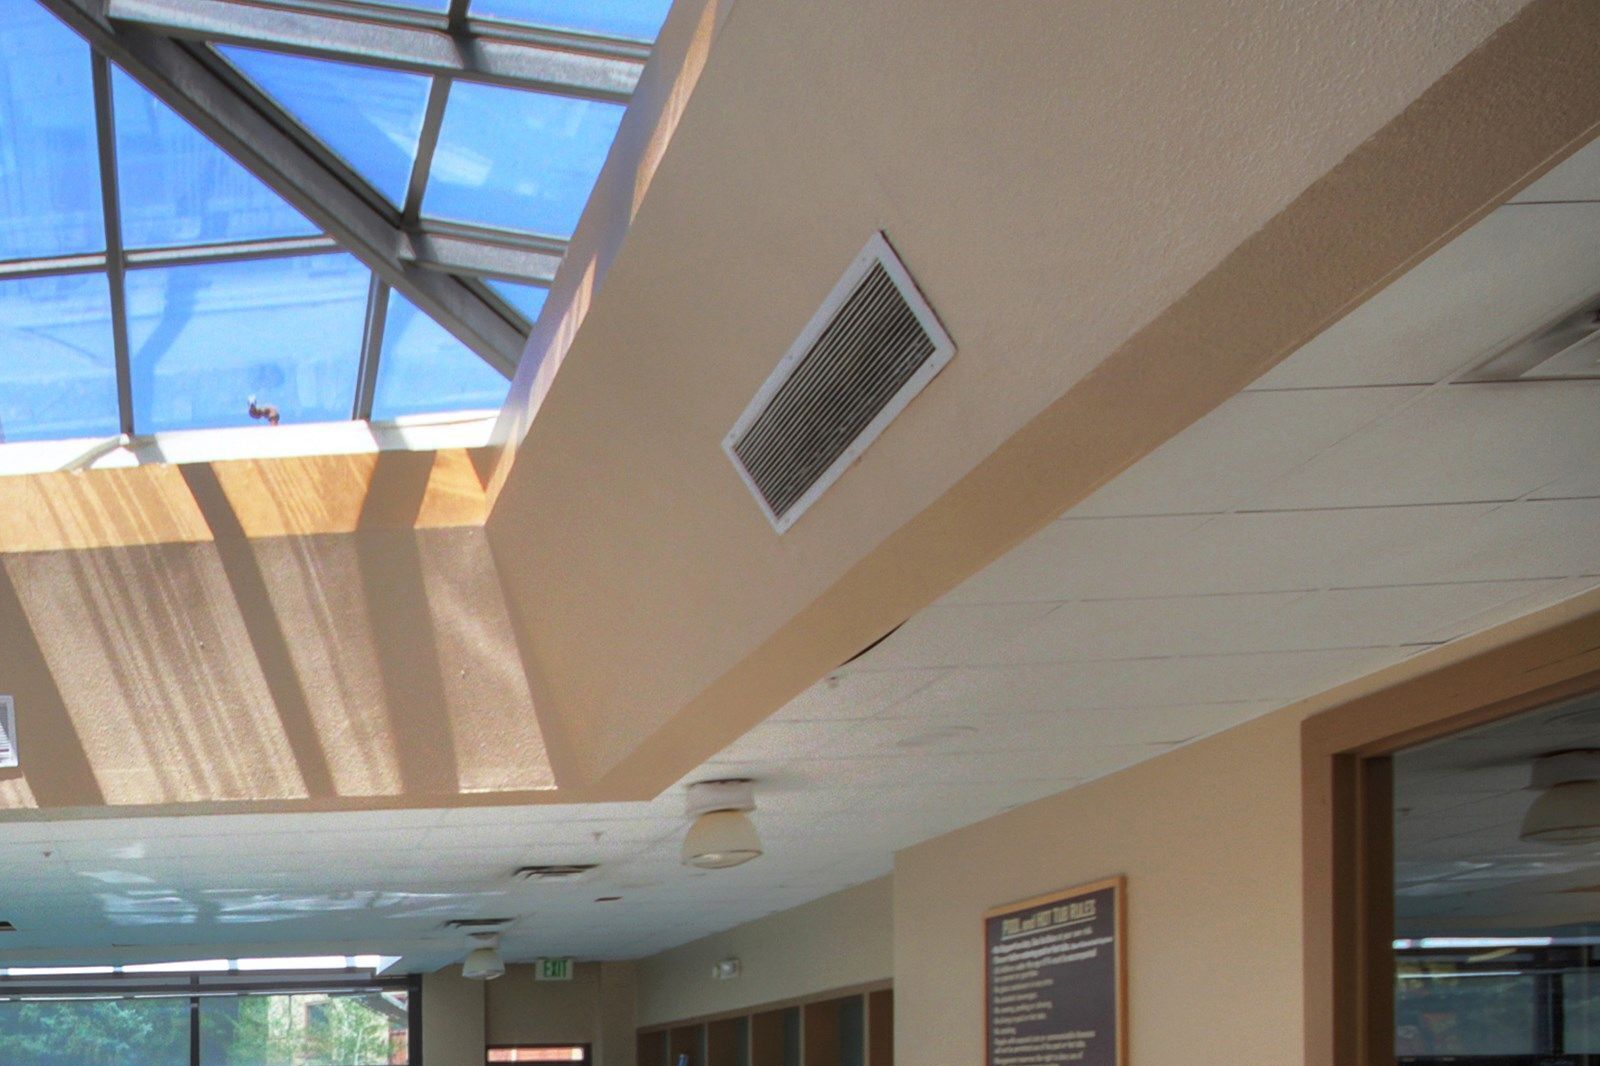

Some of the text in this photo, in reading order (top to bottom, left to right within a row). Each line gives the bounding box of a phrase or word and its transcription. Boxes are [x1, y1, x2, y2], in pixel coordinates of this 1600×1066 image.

[1002, 917, 1021, 937] POOL
[1037, 910, 1052, 927] HOT
[1053, 905, 1069, 923] TUB
[1070, 899, 1096, 919] RULES
[543, 960, 568, 977] EXIT
